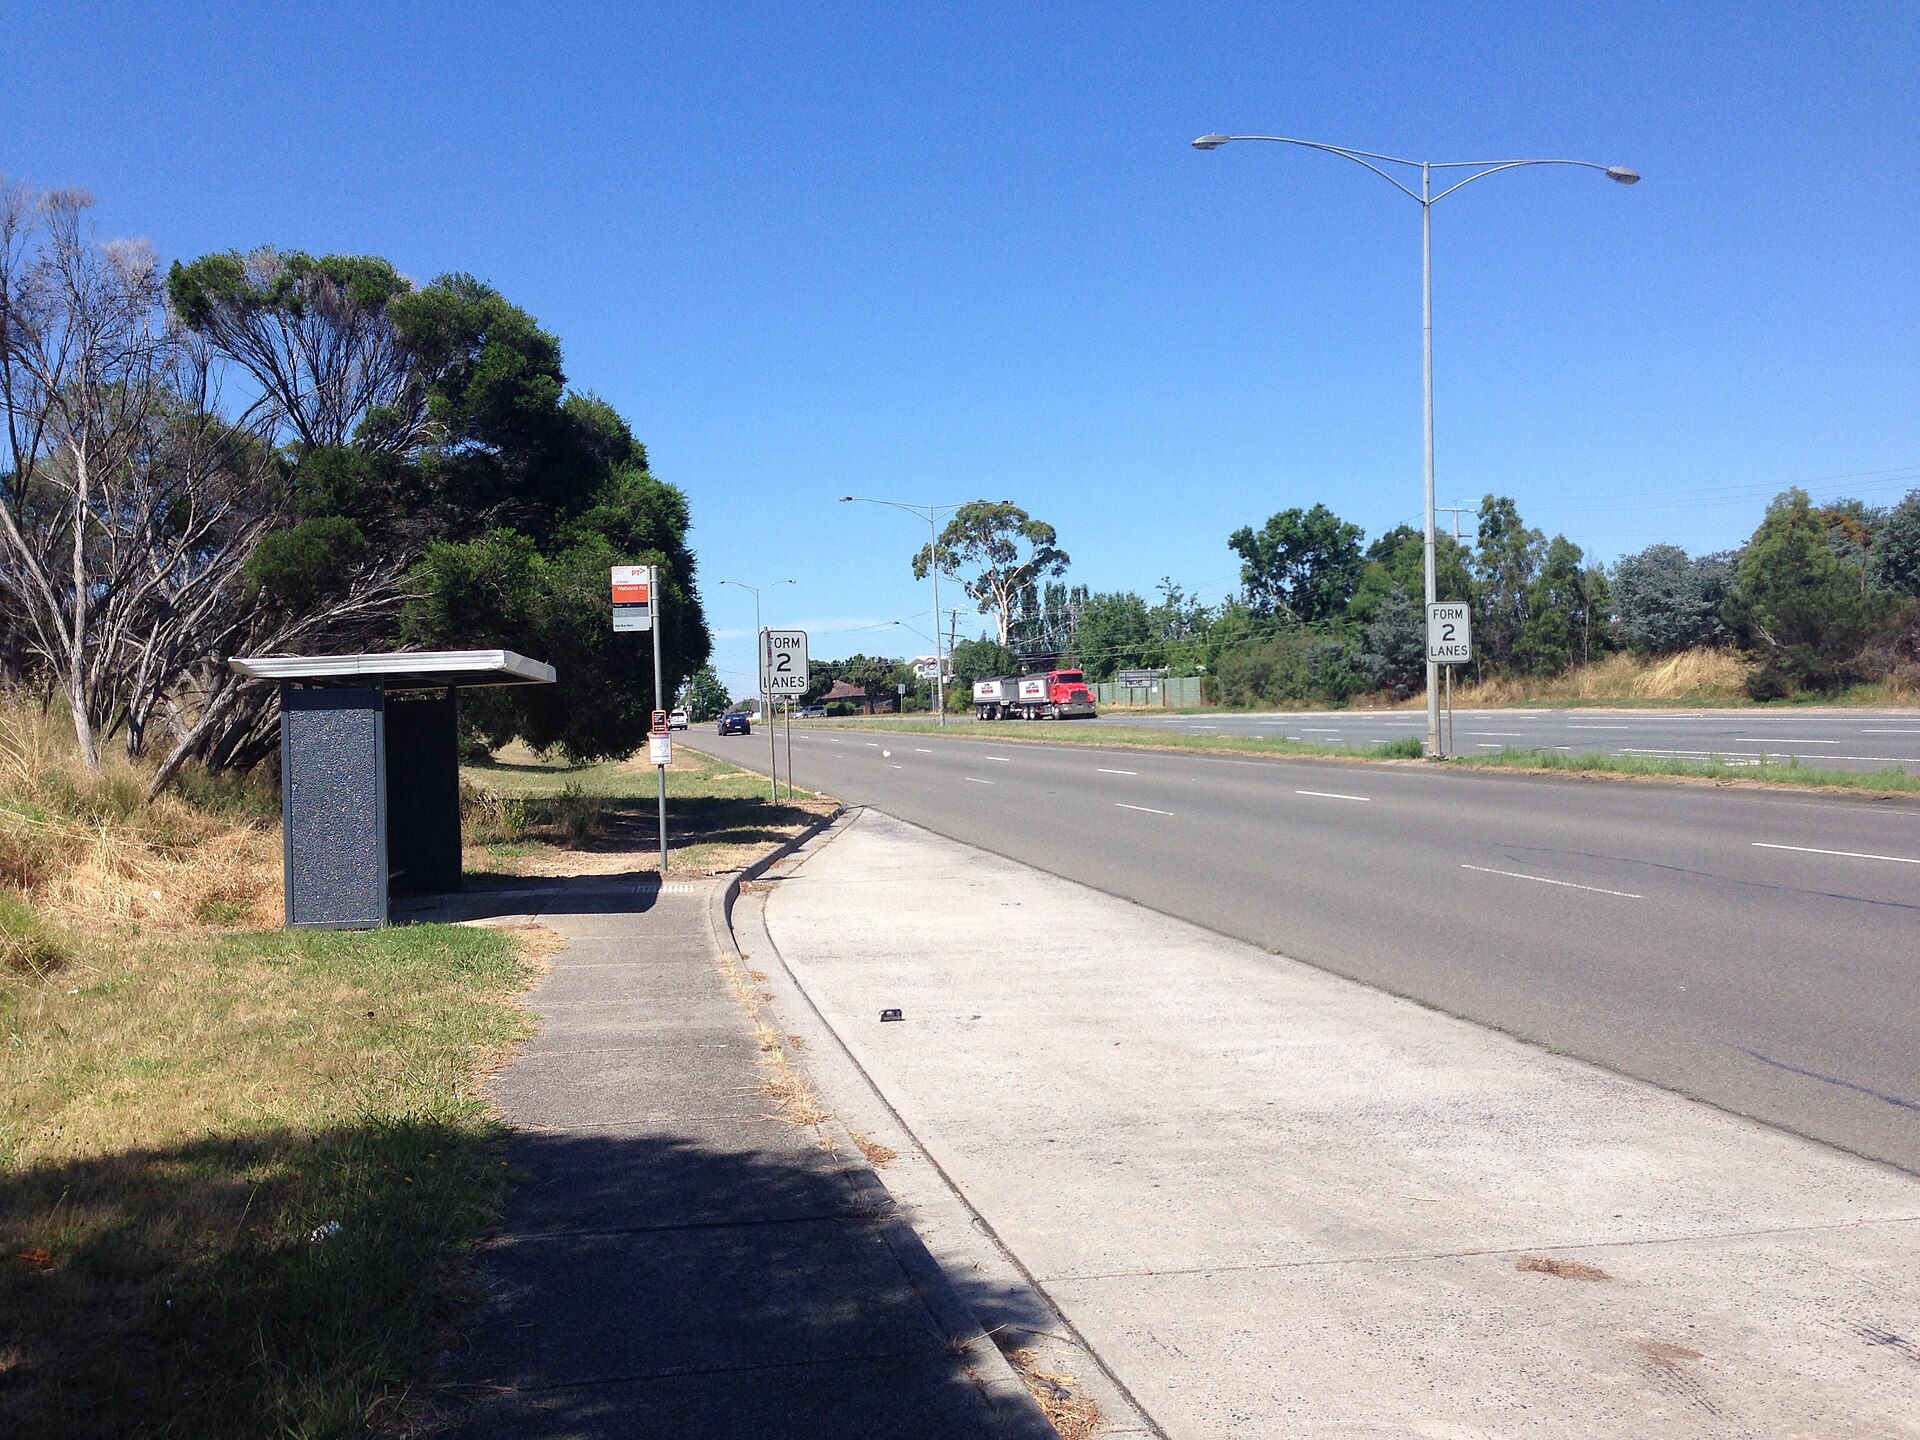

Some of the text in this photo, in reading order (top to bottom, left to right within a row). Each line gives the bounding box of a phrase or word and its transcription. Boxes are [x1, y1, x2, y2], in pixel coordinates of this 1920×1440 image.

[1433, 608, 1463, 620] FORM
[1442, 623, 1456, 641] 2
[1430, 645, 1468, 657] LANES
[776, 653, 791, 672] 2
